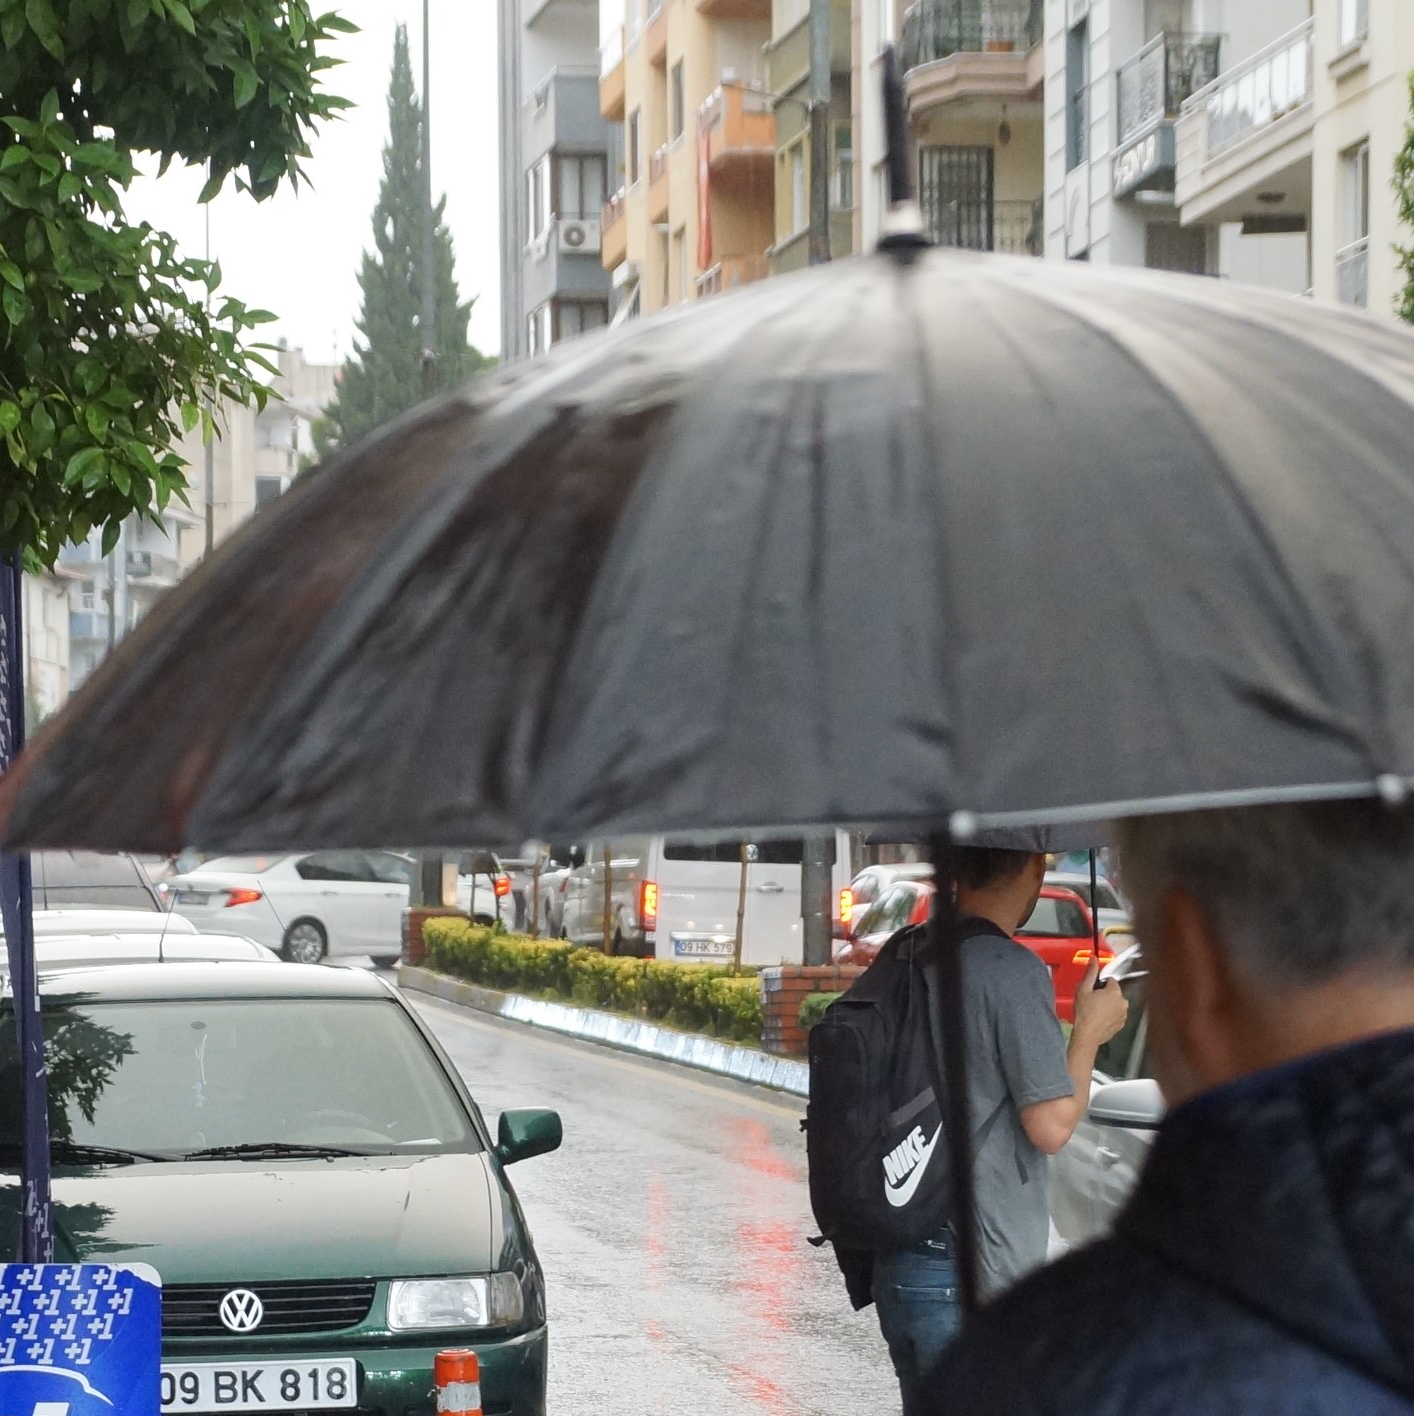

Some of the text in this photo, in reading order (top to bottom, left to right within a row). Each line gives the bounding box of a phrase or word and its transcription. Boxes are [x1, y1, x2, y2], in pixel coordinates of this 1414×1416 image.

[680, 942, 693, 952] 09
[882, 1125, 930, 1187] NIKE
[161, 1366, 348, 1406] 09 BK 818
